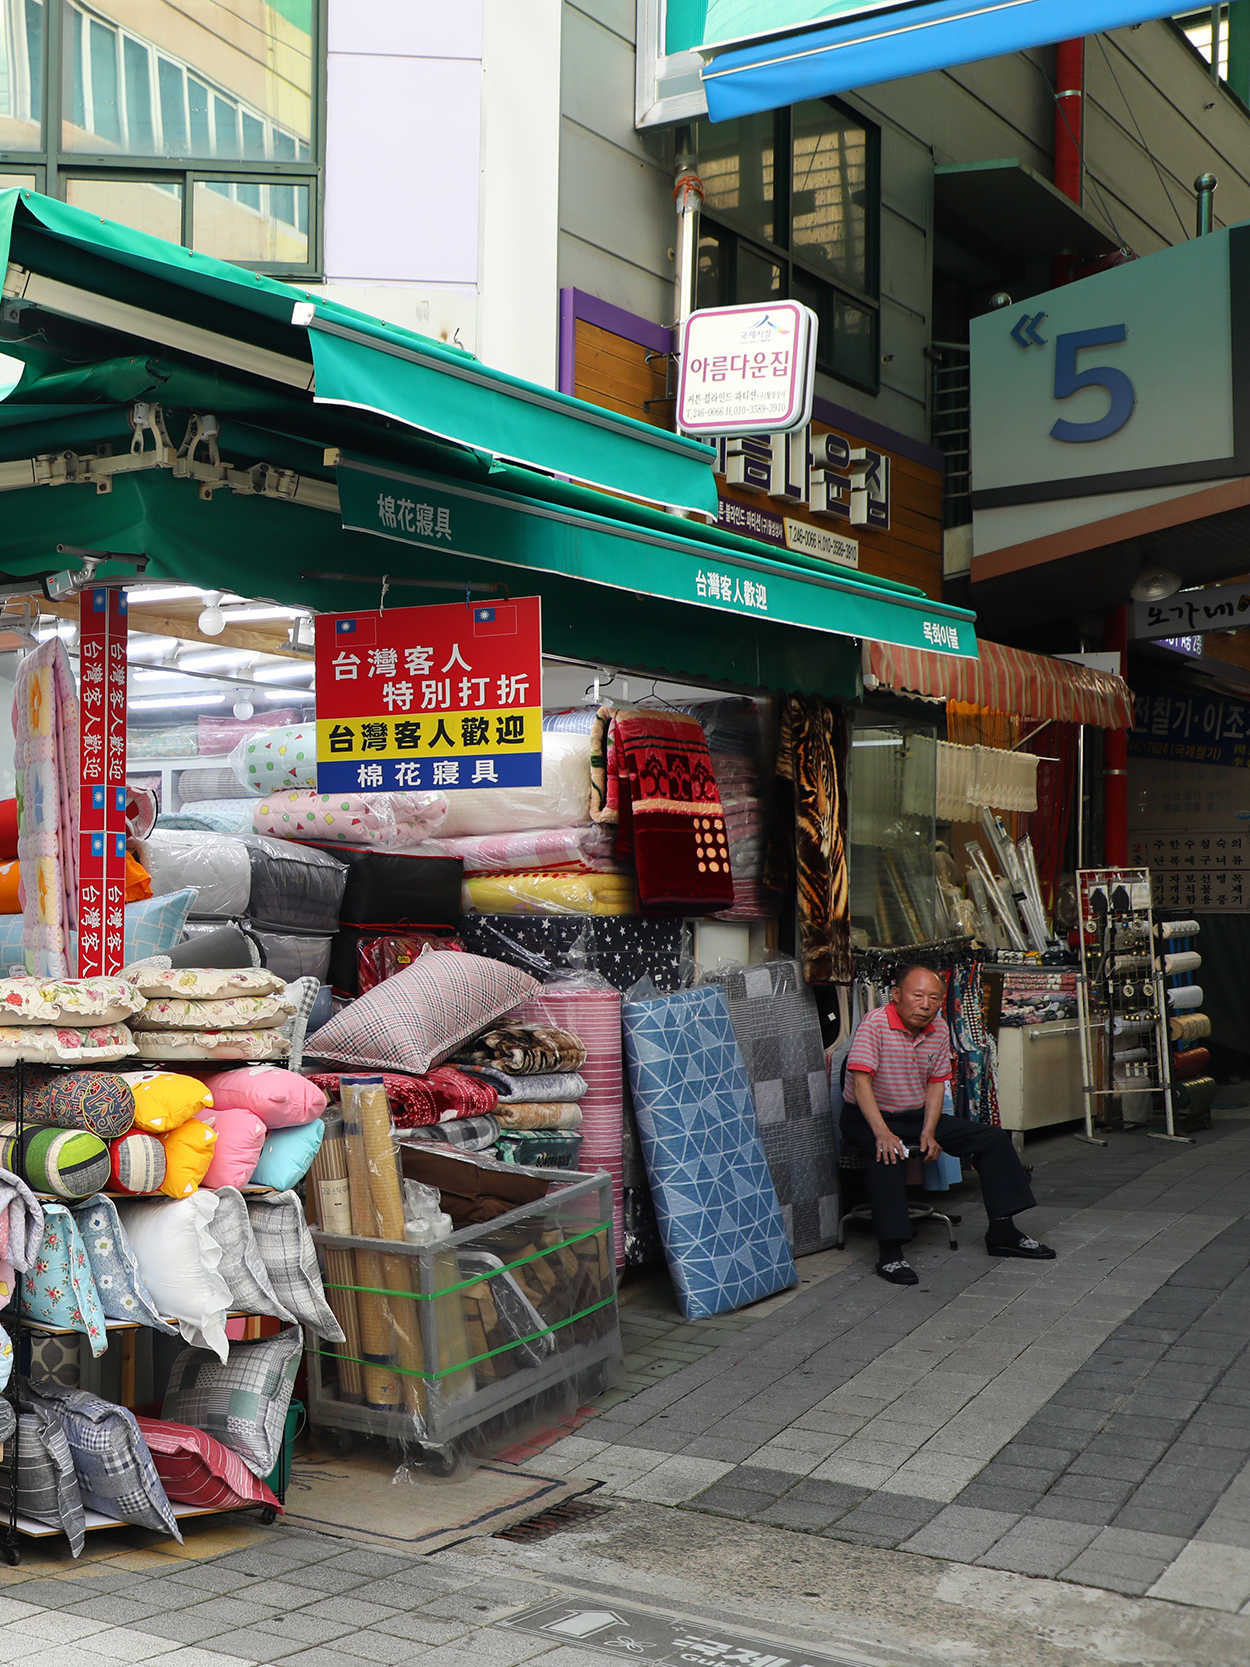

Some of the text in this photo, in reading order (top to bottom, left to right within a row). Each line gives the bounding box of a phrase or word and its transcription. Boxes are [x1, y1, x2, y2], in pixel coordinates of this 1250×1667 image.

[741, 329, 772, 339] 국제시장
[690, 350, 790, 383] 아름다운집
[1050, 323, 1135, 443] 5
[686, 402, 786, 419] T.246-0066 H.010-3589-3910
[377, 493, 452, 541] 棉花寢具
[695, 569, 768, 611] 台灣客人歡迎
[1147, 602, 1234, 629] 오가네
[923, 621, 960, 650] 목화이불
[331, 643, 472, 681] 台灣客人
[83, 641, 103, 780] 台灣客人歡迎
[109, 642, 126, 780] 台灣客人歡迎
[382, 673, 530, 711] 特別打折
[329, 715, 525, 752] 台灣客人歡迎
[357, 760, 499, 788] 棉花寢具
[81, 885, 101, 977] 台灣客人
[107, 885, 123, 976] 台灣客人
[671, 1635, 817, 1667] 국제
